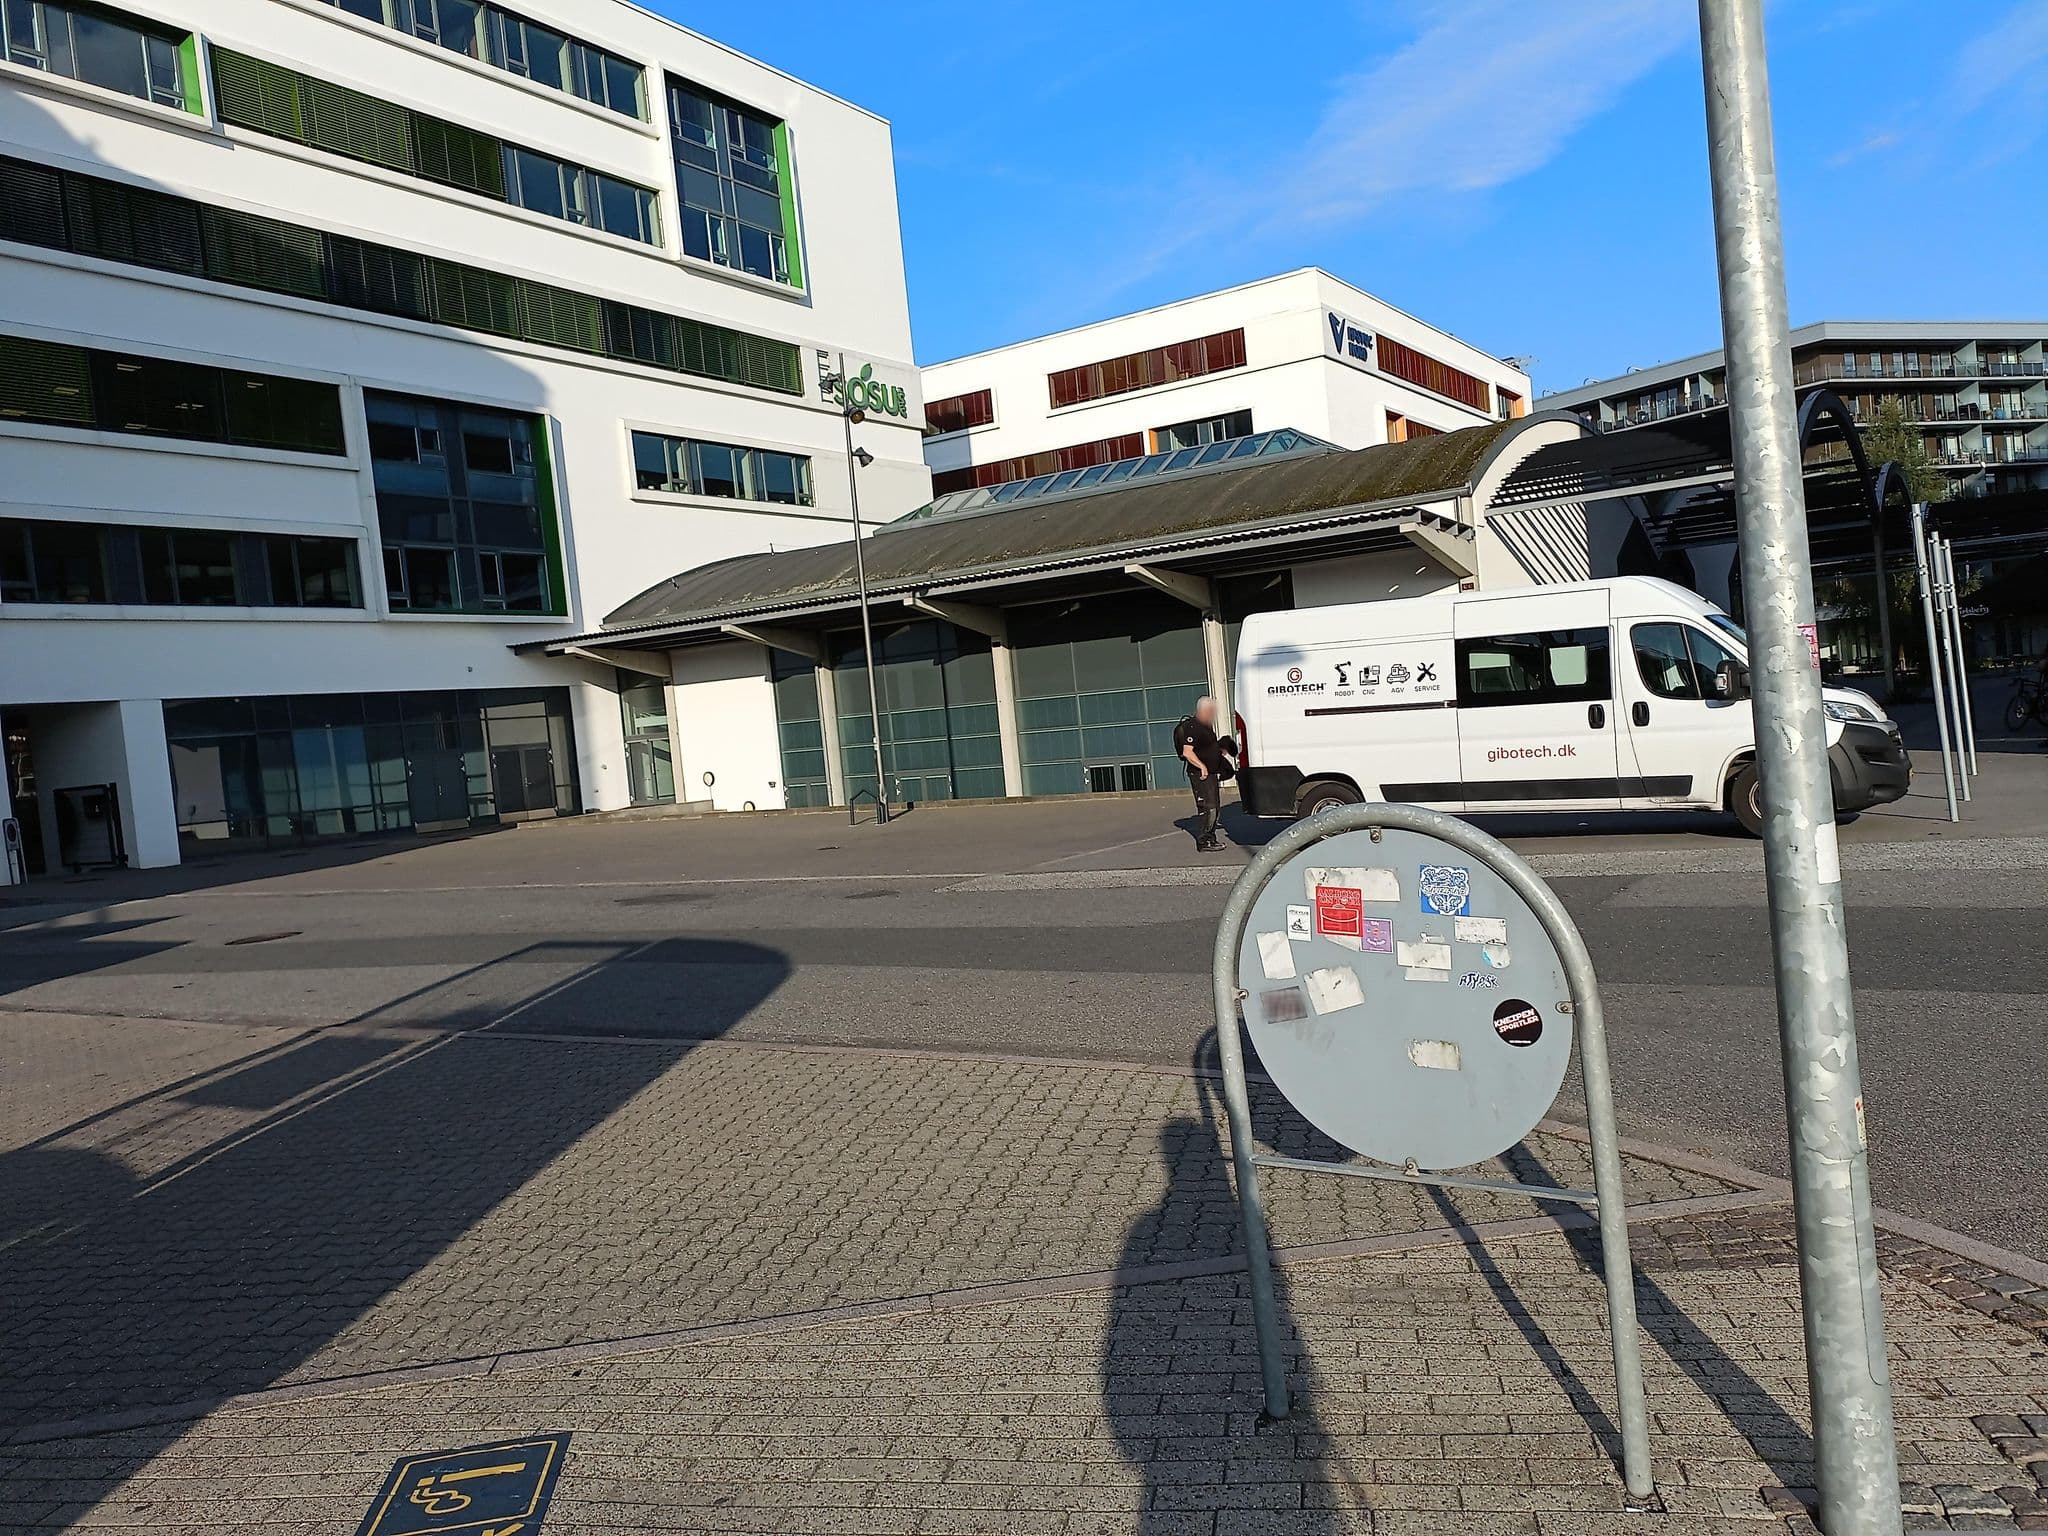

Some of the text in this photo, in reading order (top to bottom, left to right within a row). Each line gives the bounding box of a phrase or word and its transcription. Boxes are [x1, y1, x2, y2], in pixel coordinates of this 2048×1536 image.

[1267, 683, 1325, 694] GIBOTECH
[1487, 744, 1577, 763] gibotech.dk
[1494, 1008, 1535, 1028] KNEIPEN
[1498, 1015, 1540, 1033] SPORTLER
